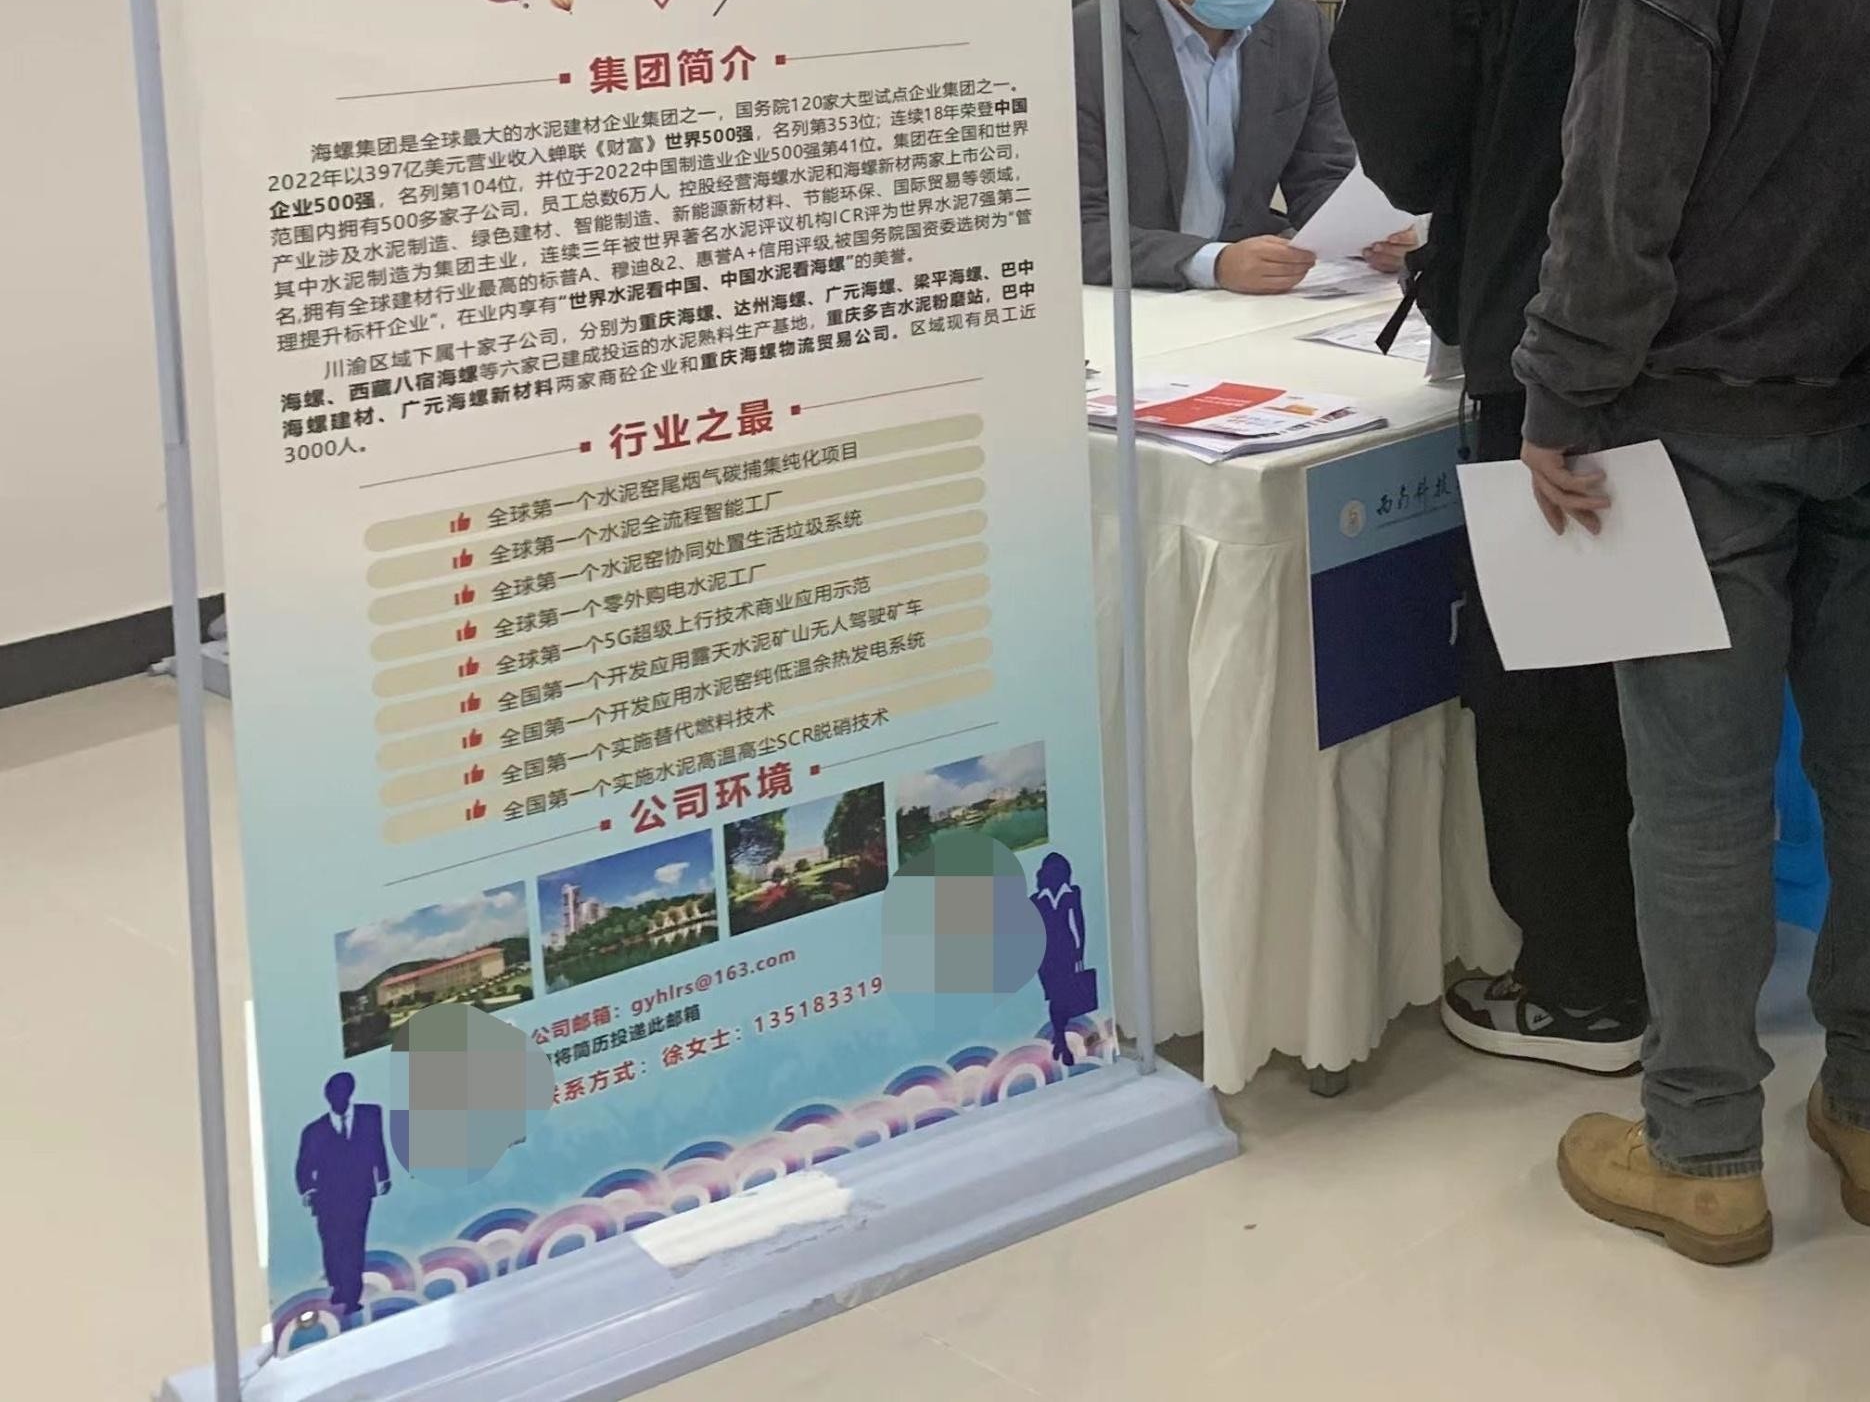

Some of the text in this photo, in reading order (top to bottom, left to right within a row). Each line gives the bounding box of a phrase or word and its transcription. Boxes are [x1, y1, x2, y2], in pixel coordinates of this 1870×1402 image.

[589, 45, 756, 94] 集团简介
[284, 440, 367, 463] 3000人。
[609, 398, 773, 459] 行业之最
[488, 441, 858, 529] 全球第一个水泥窑尾烟气碳捕集纯化项目
[490, 490, 783, 566] 全球第一个水泥全流程智能工厂
[492, 509, 863, 602] 全球第一个水泥窑协同处置生活垃圾系统
[493, 563, 767, 639] 全球第一个零外购电水泥工厂
[496, 576, 871, 675] 全球第一个5G超级上行技术商业应用示范
[497, 598, 924, 712] 全国第一个开发应用露天水泥矿山无人驾驶矿车
[500, 631, 926, 748] 全国第一个开发应用水泥窑纯低温余热发电系统
[501, 701, 775, 785] 全国第一个实施替代燃料技术
[503, 708, 889, 821] 全国第一个实施水泥高温高尘SCR脱硝技术
[630, 762, 794, 833] 公司环境
[546, 1003, 701, 1067] 将简历投递此邮箱
